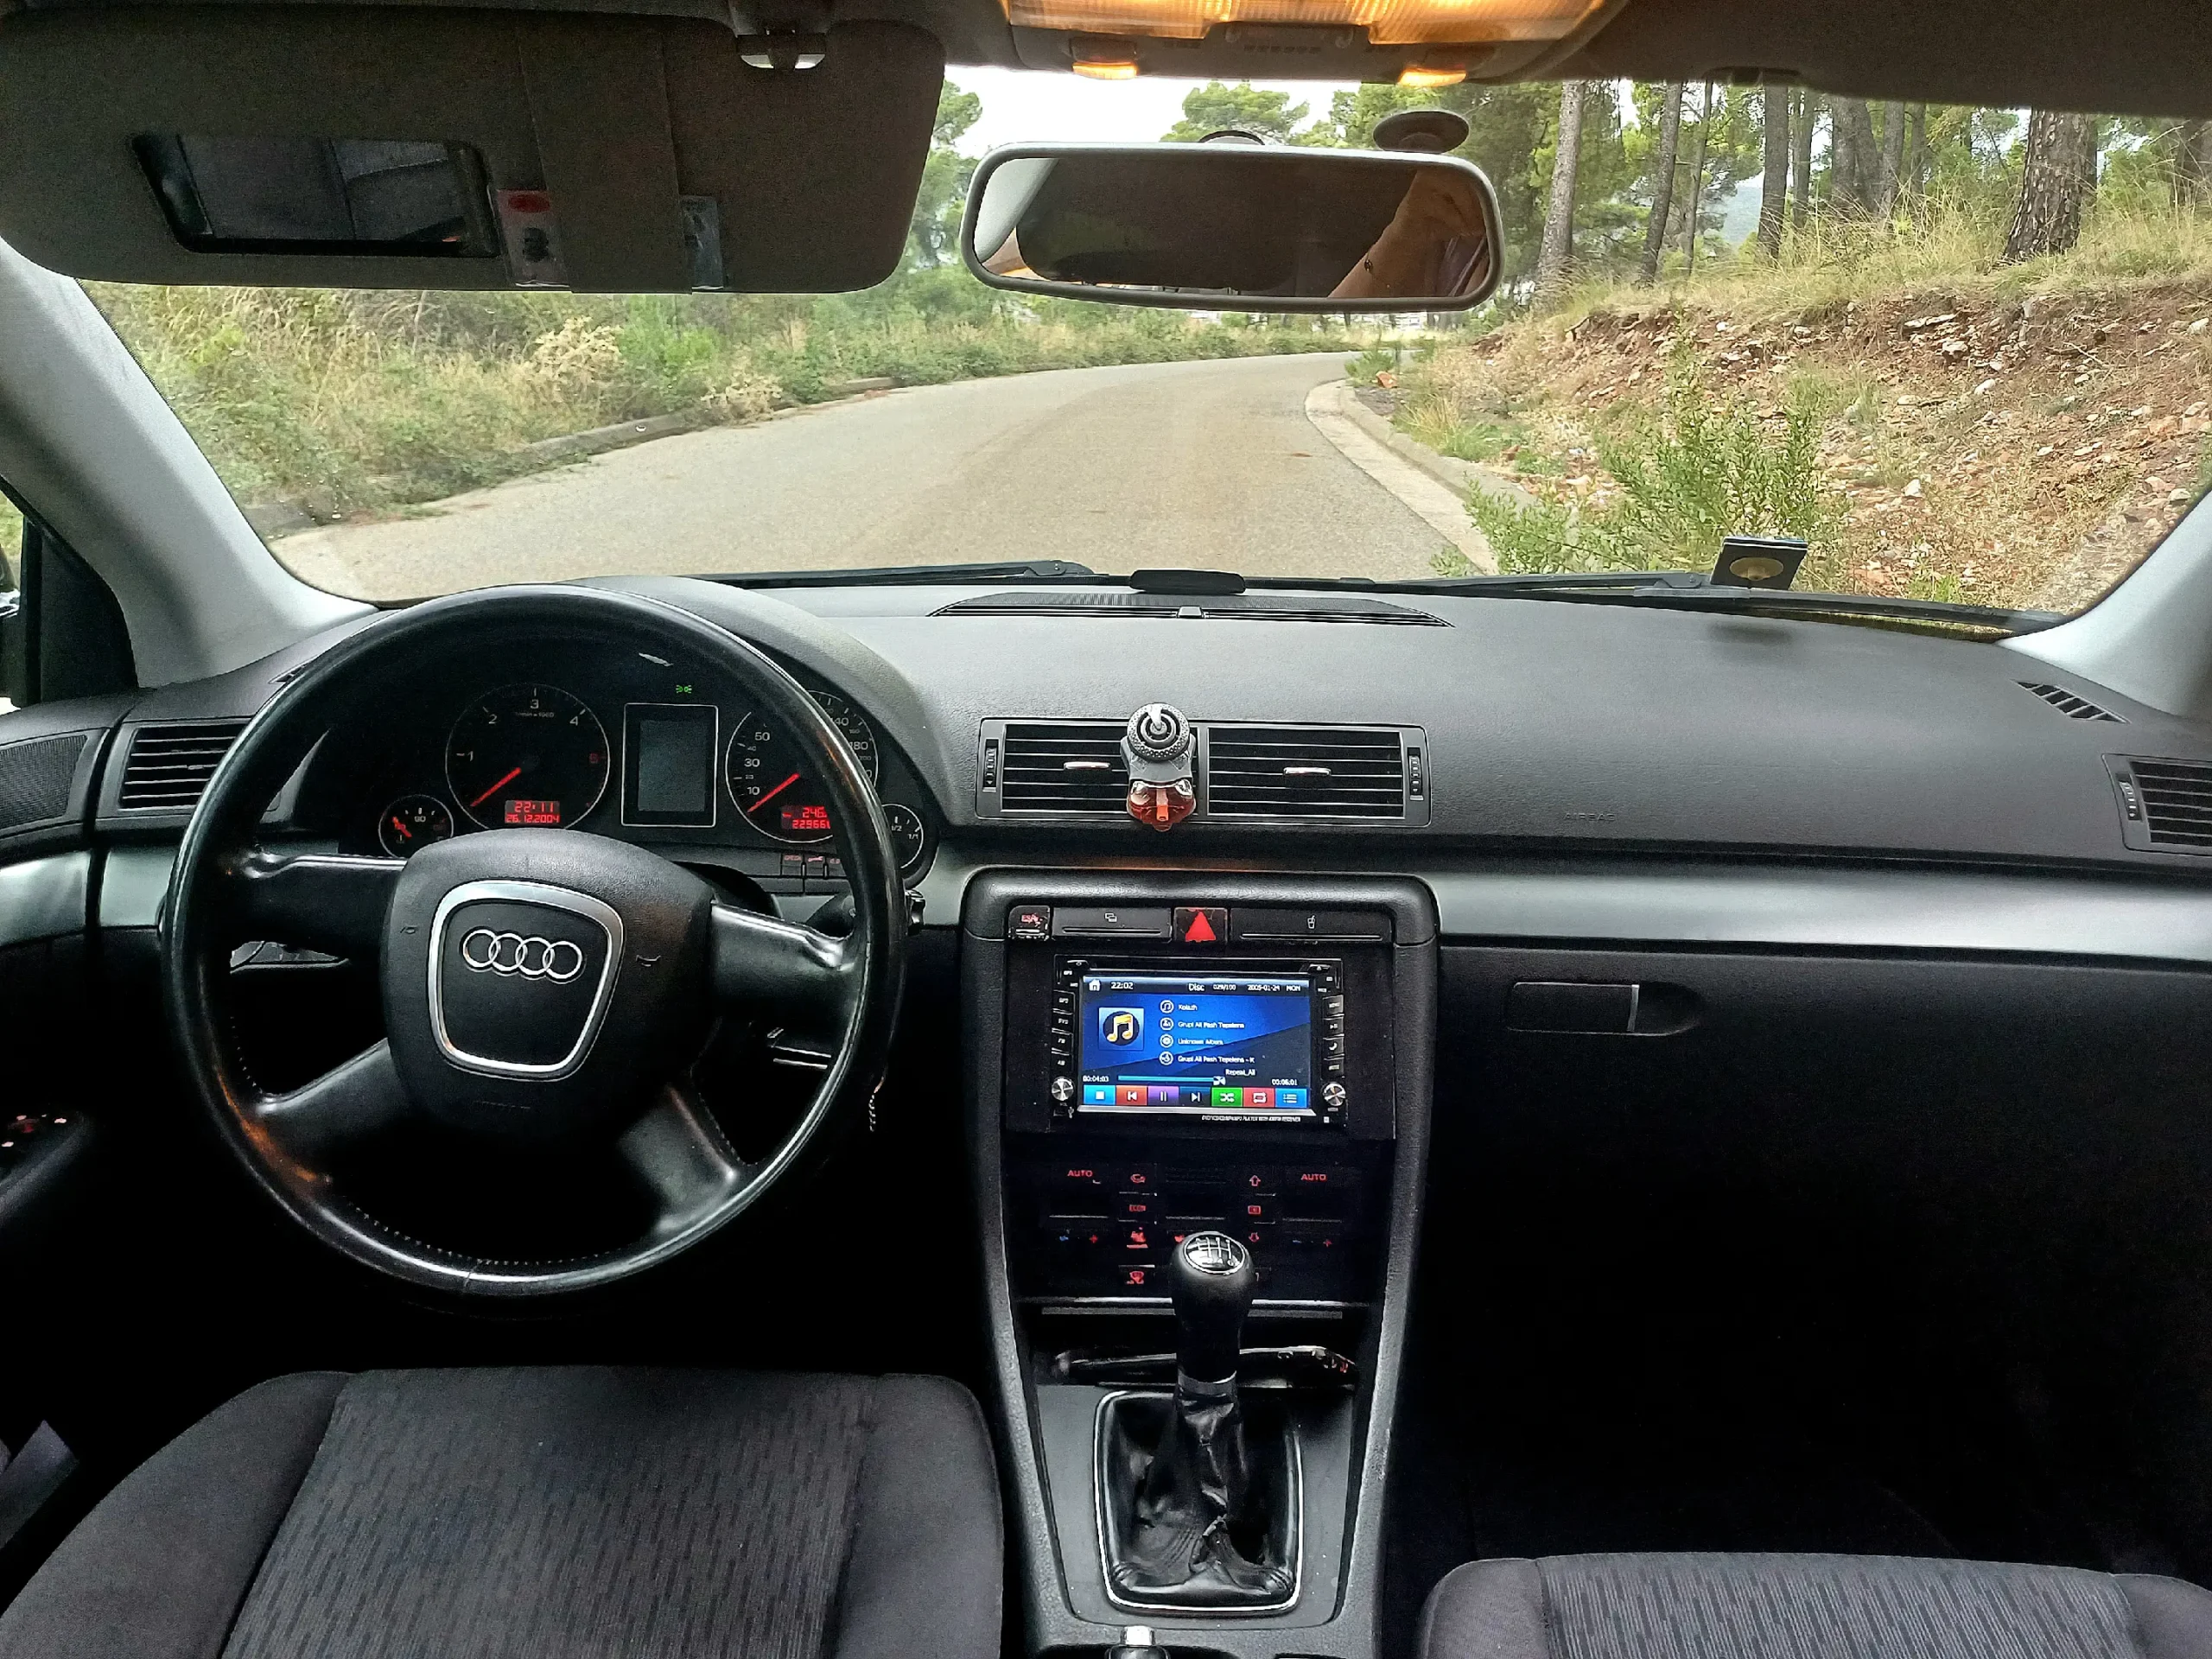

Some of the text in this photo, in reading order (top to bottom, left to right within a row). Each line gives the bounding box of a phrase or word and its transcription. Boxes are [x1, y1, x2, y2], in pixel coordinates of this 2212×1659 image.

[530, 699, 539, 709] 3
[488, 715, 498, 724] 2
[569, 715, 579, 726] 4
[754, 732, 771, 741] 50
[468, 751, 474, 761] 1
[744, 758, 760, 767] 30
[747, 786, 760, 796] 10
[514, 801, 554, 813] 22:11
[1564, 812, 1615, 822] AIRBAG
[1110, 981, 1135, 990] 22:02
[1188, 982, 1205, 992] Disc
[1067, 1169, 1093, 1178] AUTO
